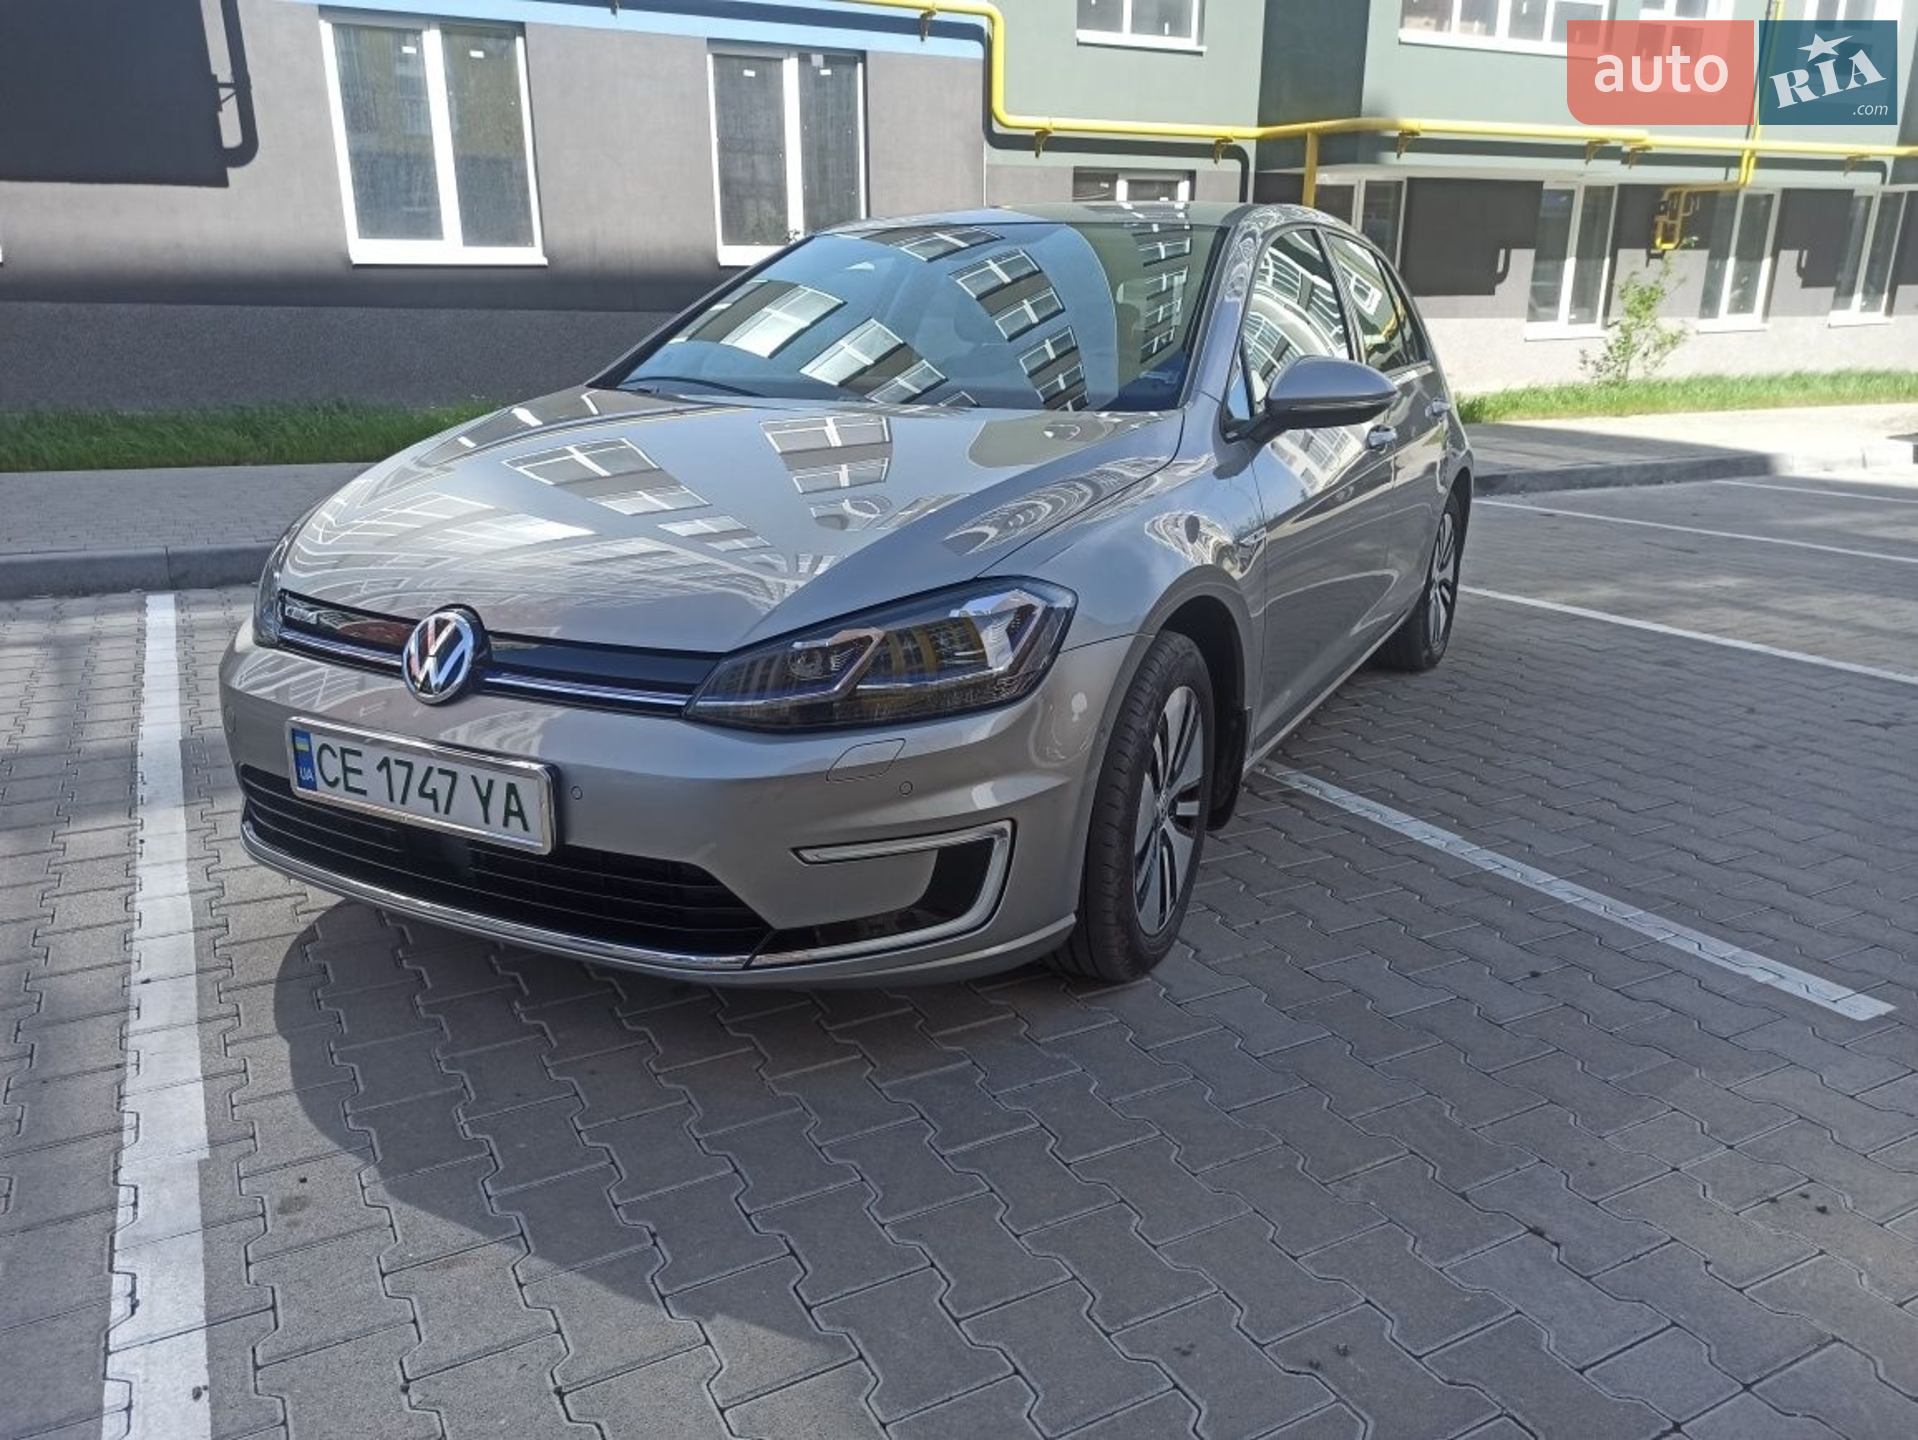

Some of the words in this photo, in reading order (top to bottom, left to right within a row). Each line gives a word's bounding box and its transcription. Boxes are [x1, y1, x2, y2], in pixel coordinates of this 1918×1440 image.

[299, 767, 315, 782] UA
[316, 742, 367, 796] CE
[376, 756, 458, 815] 1747
[471, 774, 530, 833] YA
